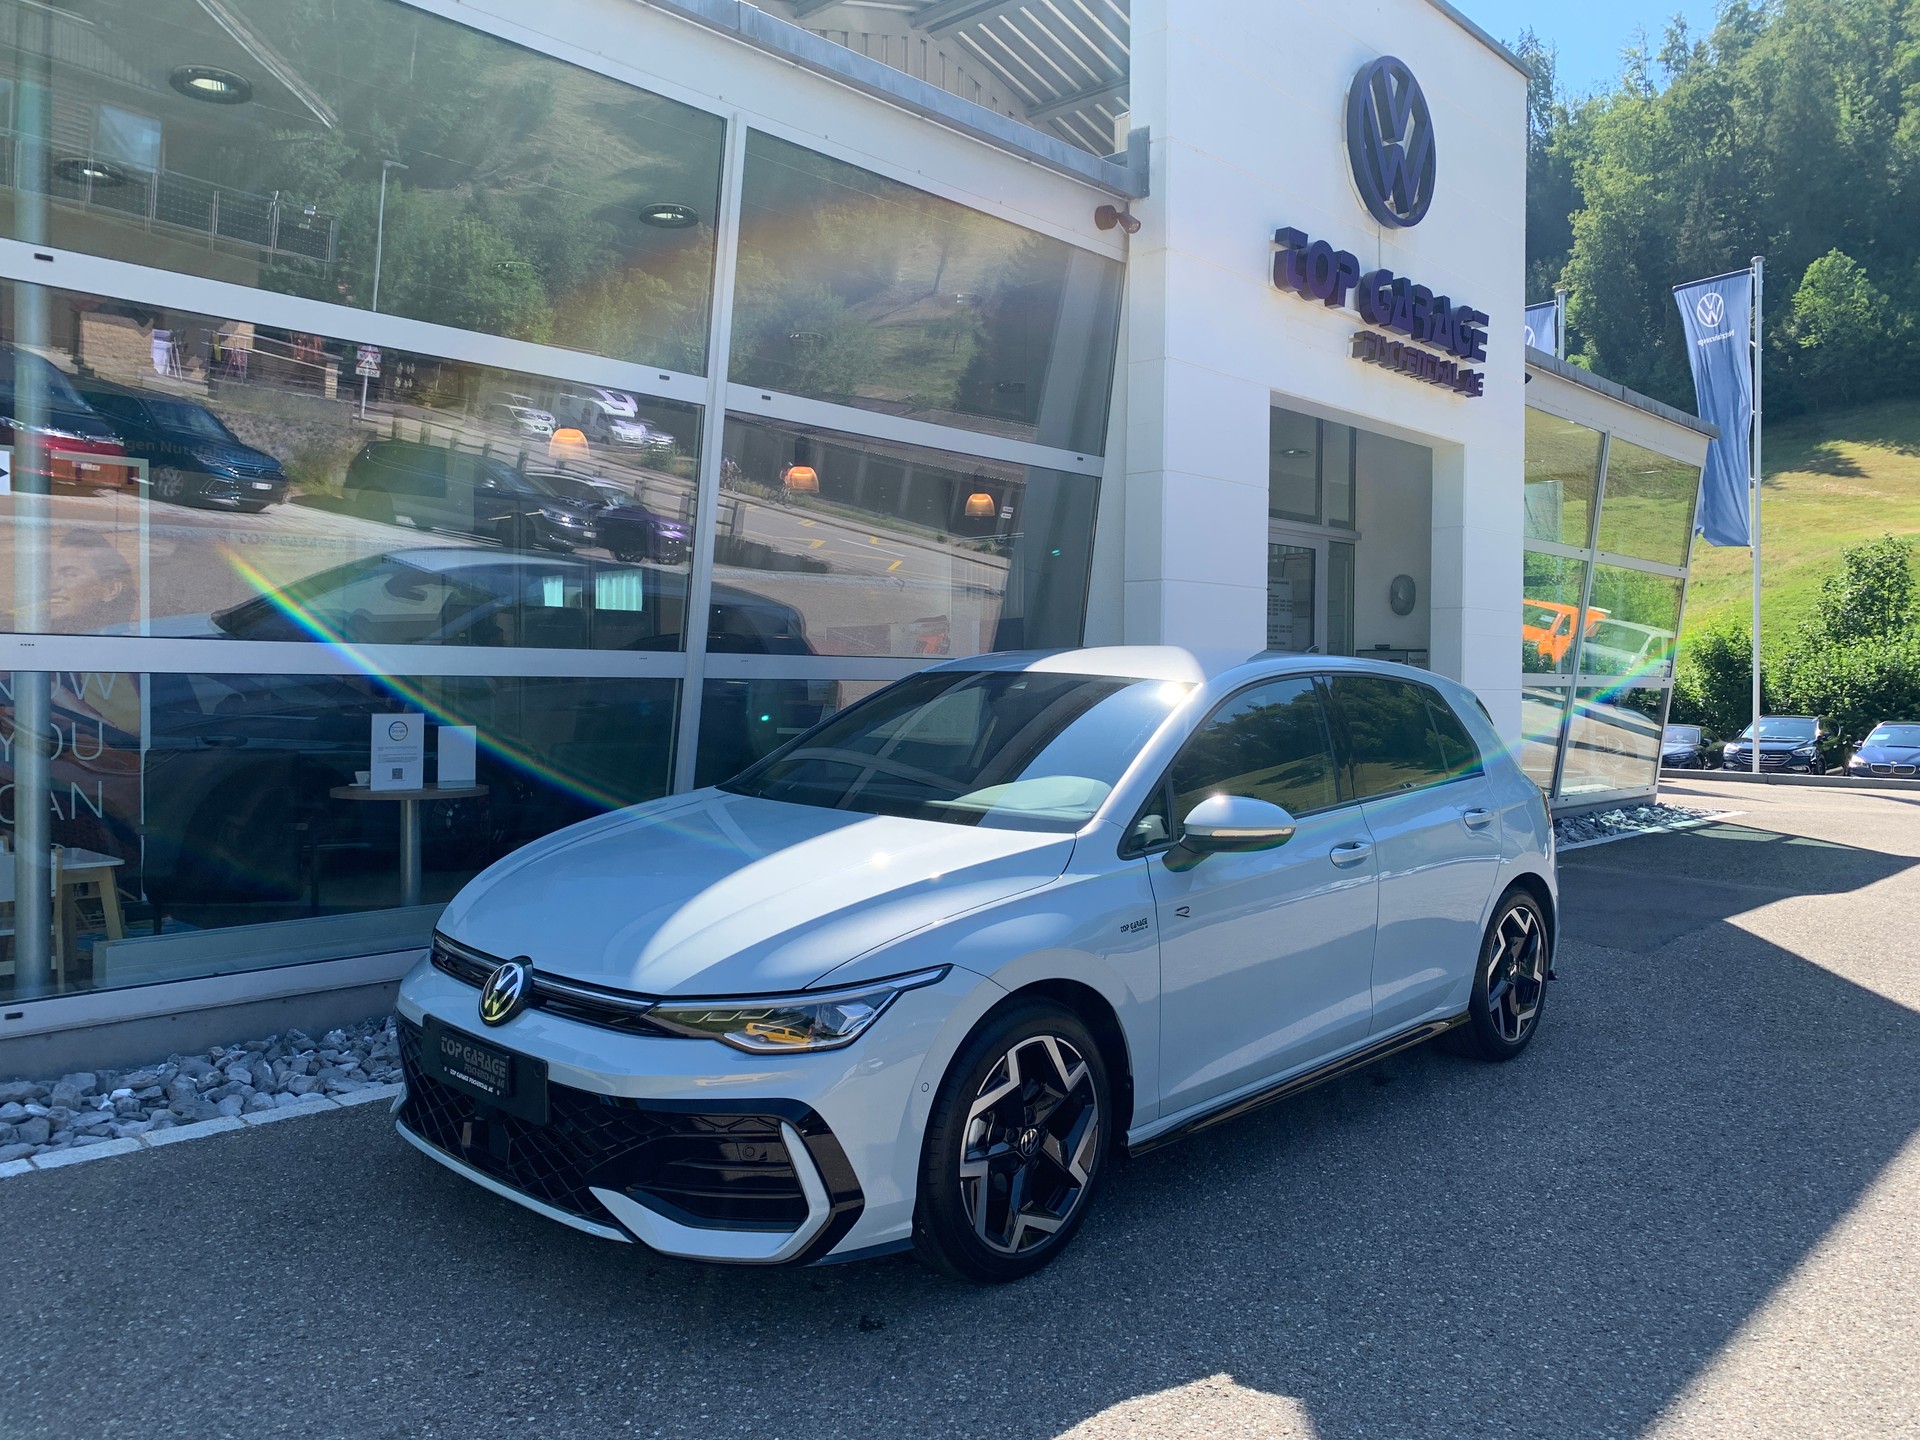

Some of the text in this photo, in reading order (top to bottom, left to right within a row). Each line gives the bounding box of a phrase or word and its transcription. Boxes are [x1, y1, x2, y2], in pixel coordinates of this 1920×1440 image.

[1273, 227, 1490, 364] TOP GARAGE
[1352, 330, 1485, 398] FISCHENTHAL AG
[441, 1036, 506, 1079] TOP GARAGE
